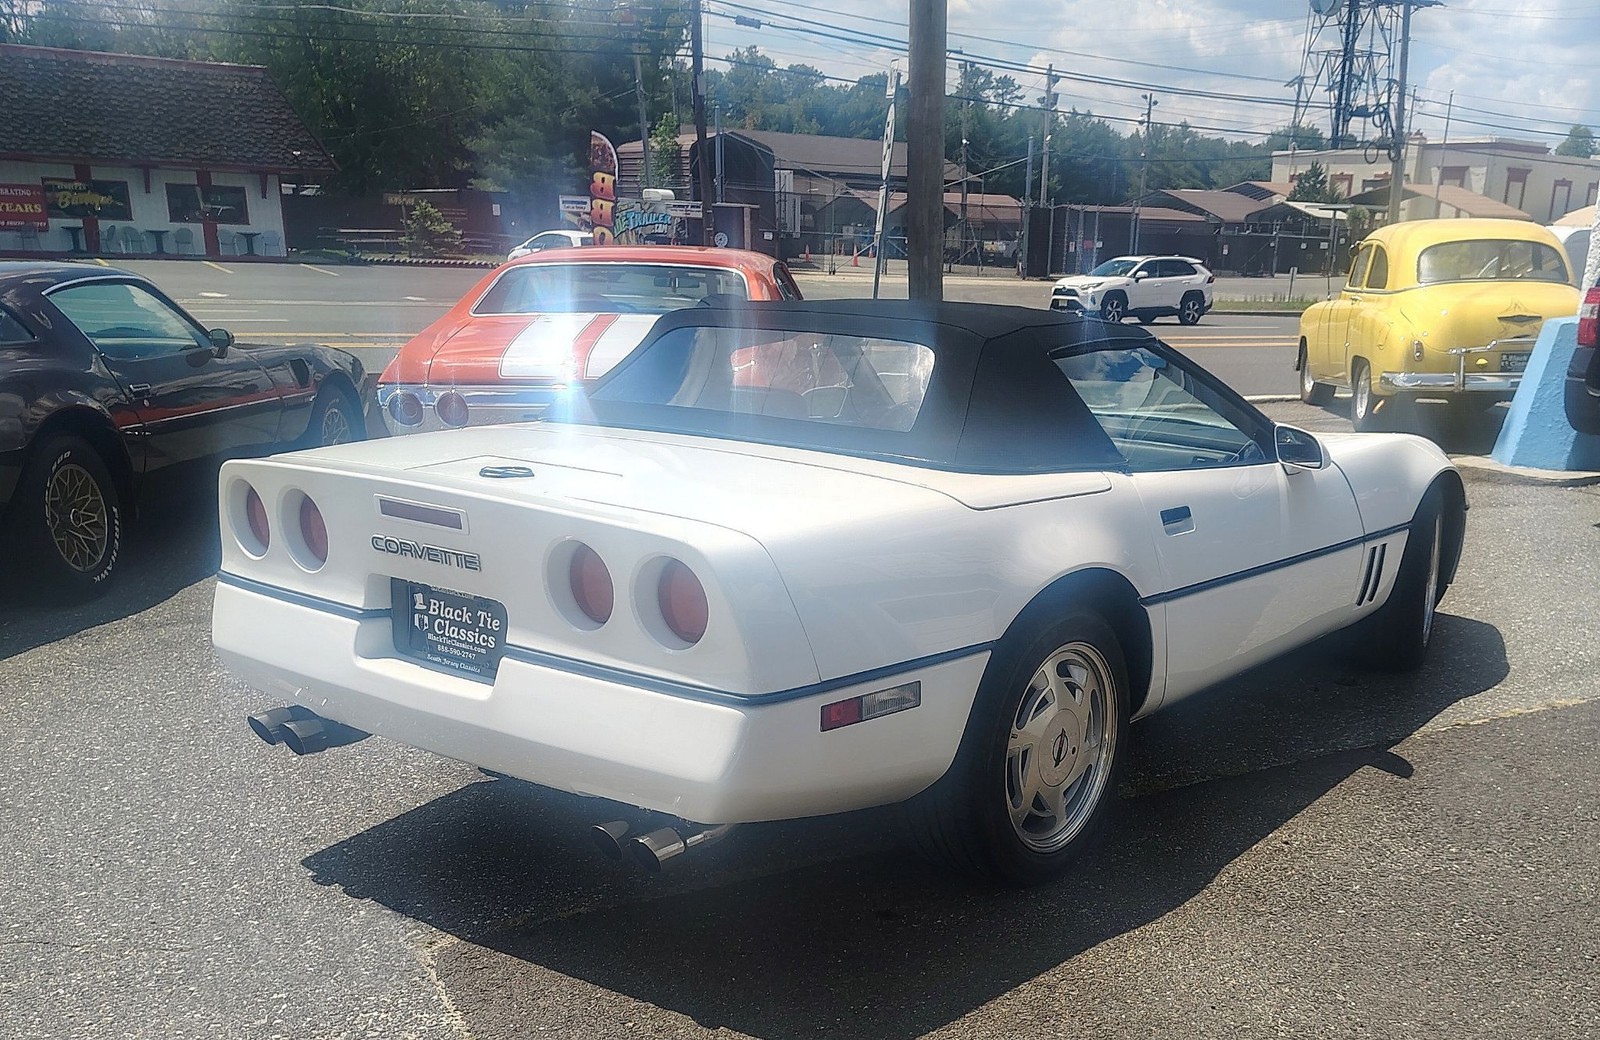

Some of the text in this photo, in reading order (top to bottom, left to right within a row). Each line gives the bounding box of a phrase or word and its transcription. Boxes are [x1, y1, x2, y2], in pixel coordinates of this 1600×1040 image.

[371, 534, 481, 572] CORVETTE
[428, 598, 500, 631] Black Tie
[427, 632, 487, 654] BlackTieClassics.com
[434, 618, 496, 648] Classics
[427, 653, 481, 673] South Jersey Classics
